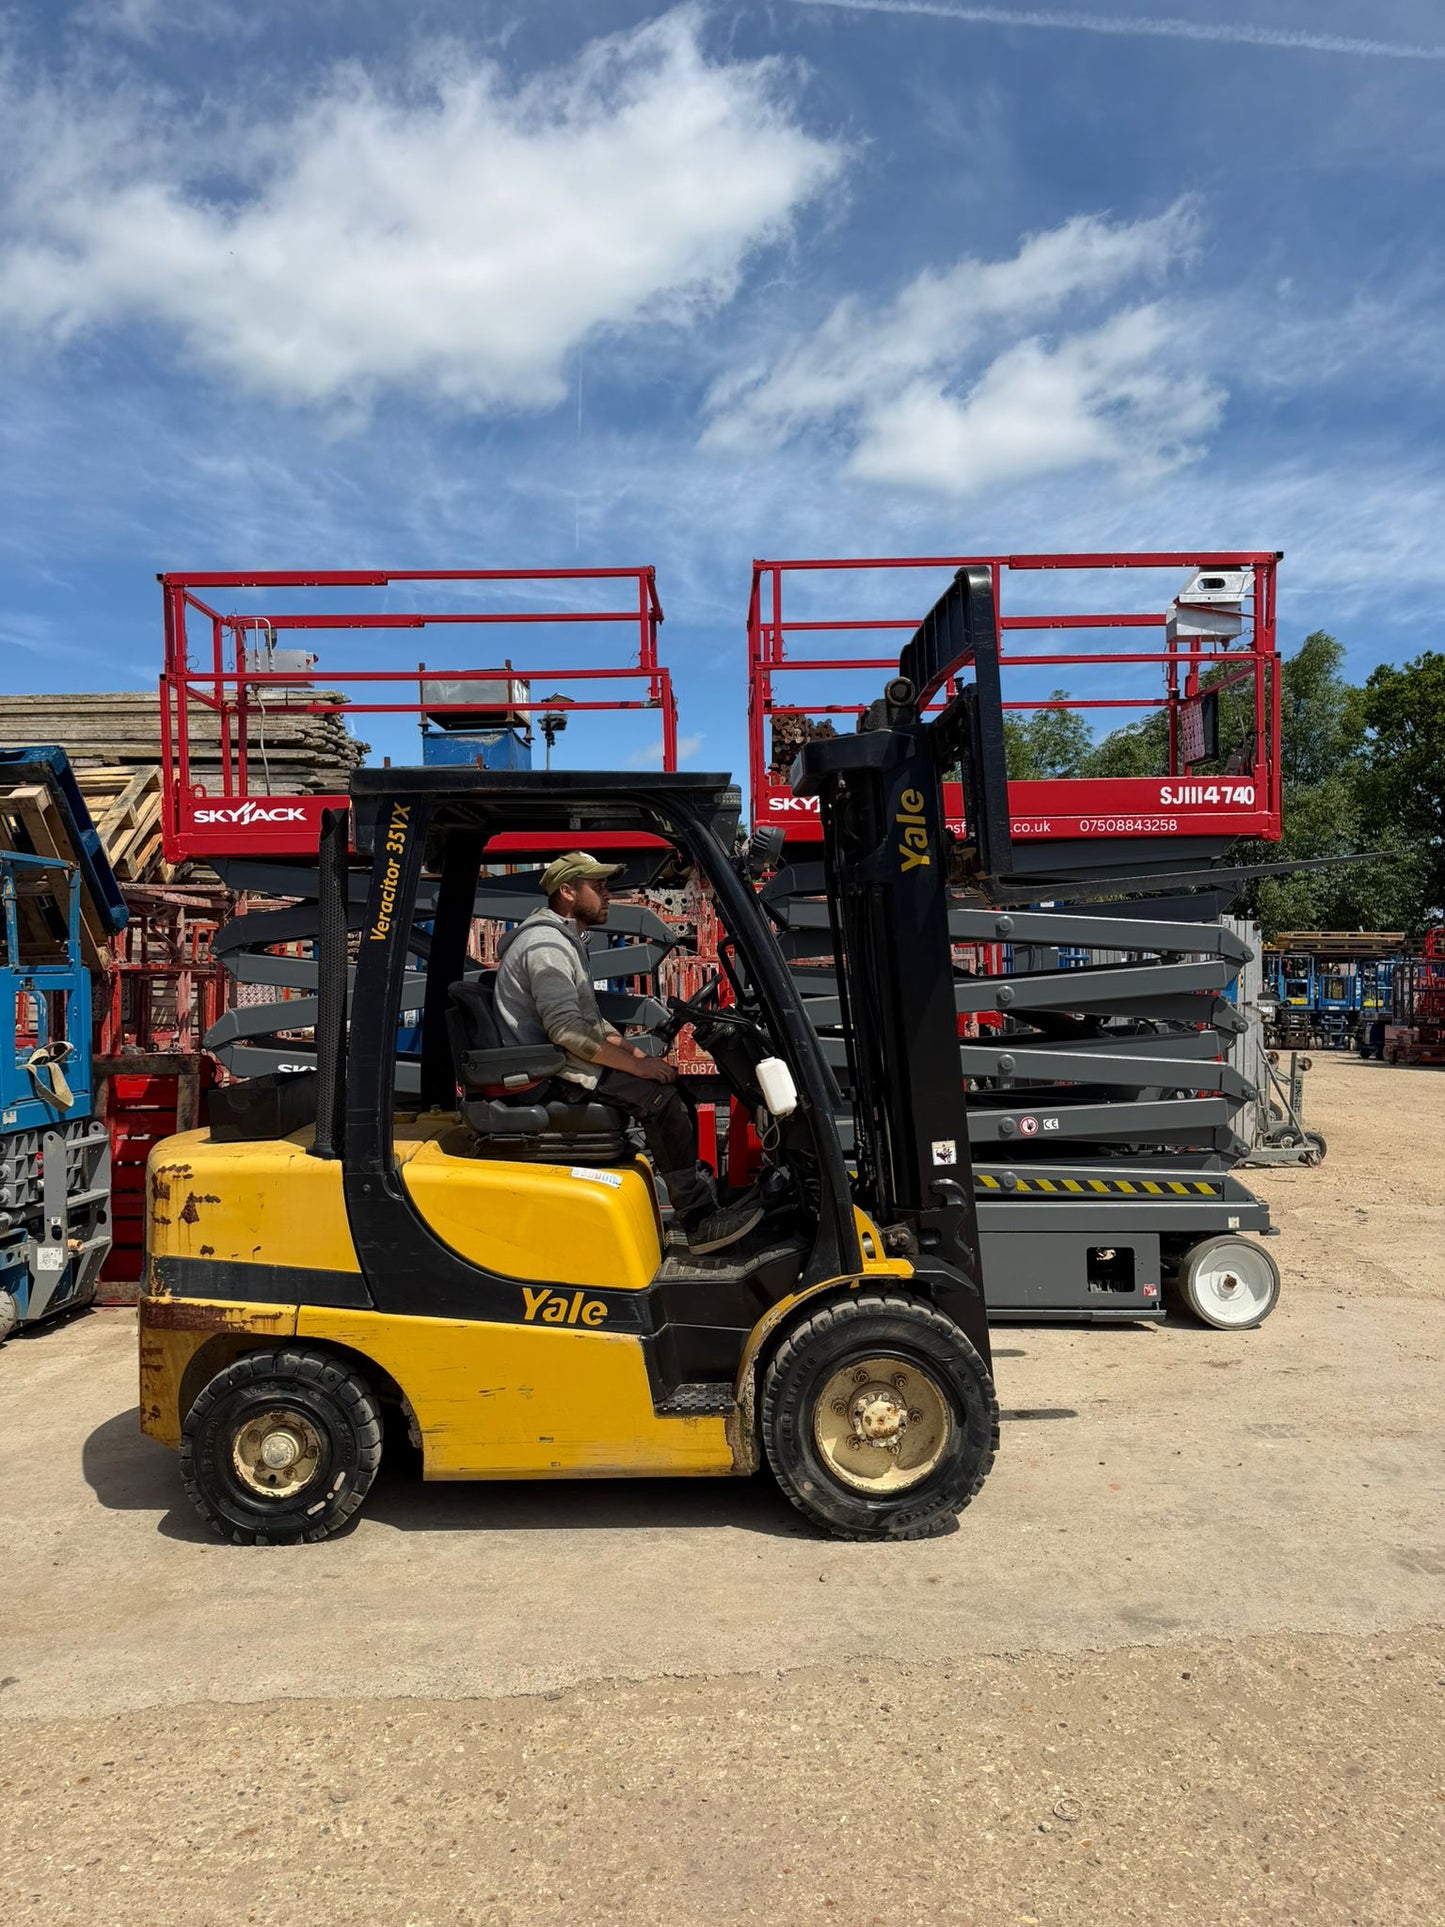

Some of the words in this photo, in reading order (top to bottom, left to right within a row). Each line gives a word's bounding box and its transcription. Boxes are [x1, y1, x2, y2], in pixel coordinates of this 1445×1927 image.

[193, 801, 307, 825] SKYJACK
[896, 788, 930, 872] Yale
[1079, 819, 1178, 832] 07508843258
[370, 858, 401, 940] Veracitor
[386, 802, 412, 855] 35VX
[522, 1287, 608, 1326] Yale
